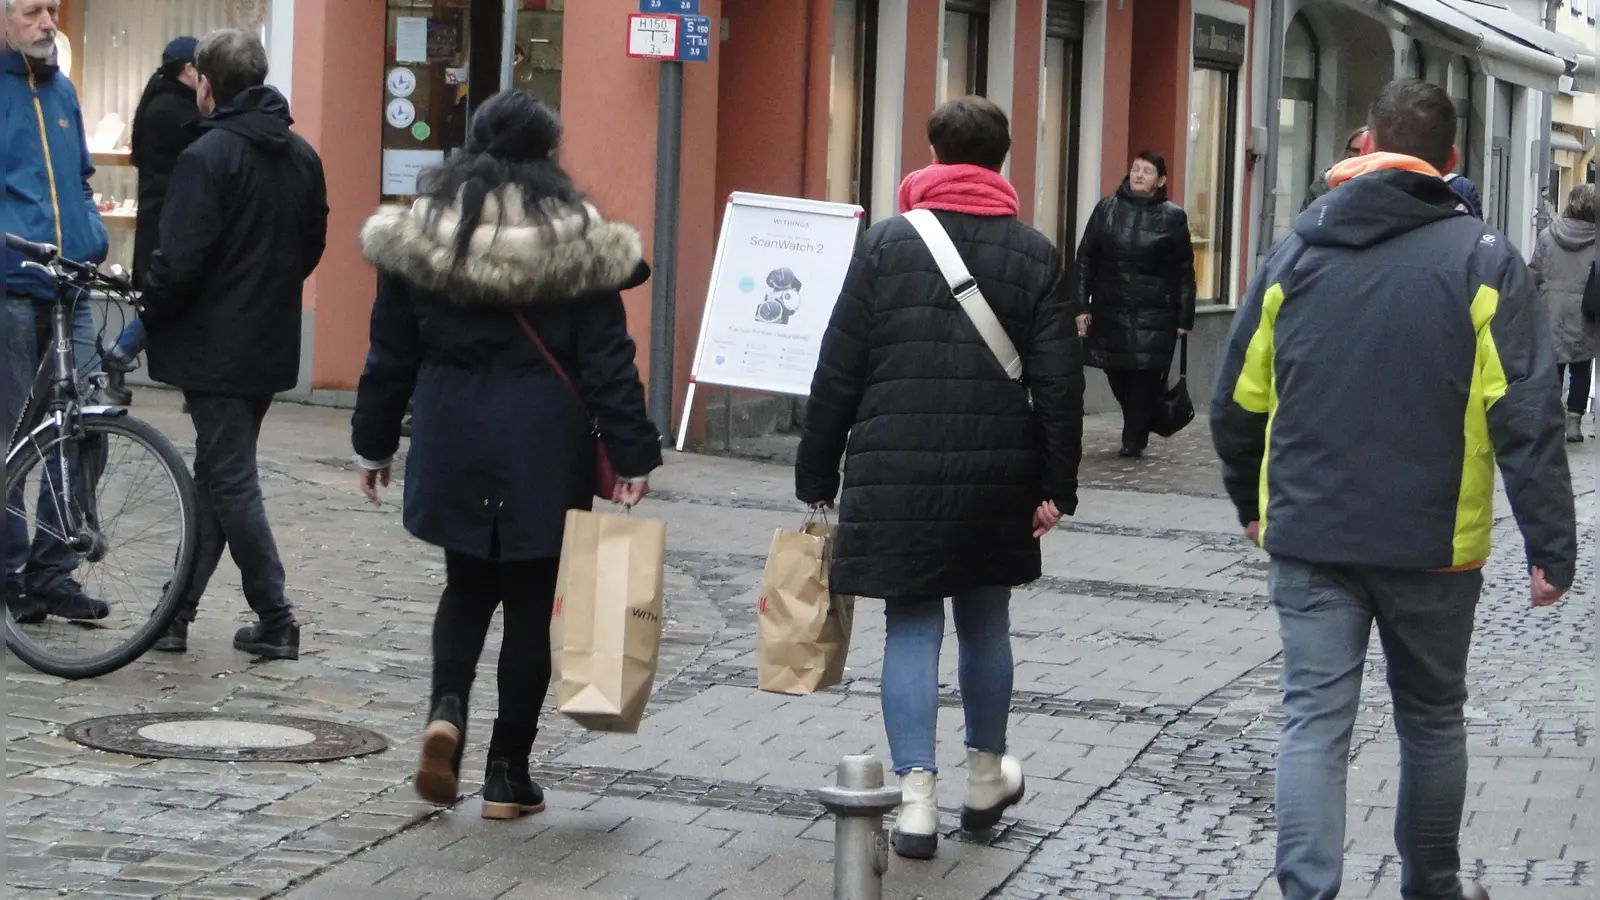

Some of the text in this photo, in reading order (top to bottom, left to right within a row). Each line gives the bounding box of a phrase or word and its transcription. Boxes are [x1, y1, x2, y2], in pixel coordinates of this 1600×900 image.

[687, 22, 695, 32] S
[773, 219, 809, 228] WITHINGS
[749, 236, 814, 252] ScanWatch
[816, 244, 824, 254] 2
